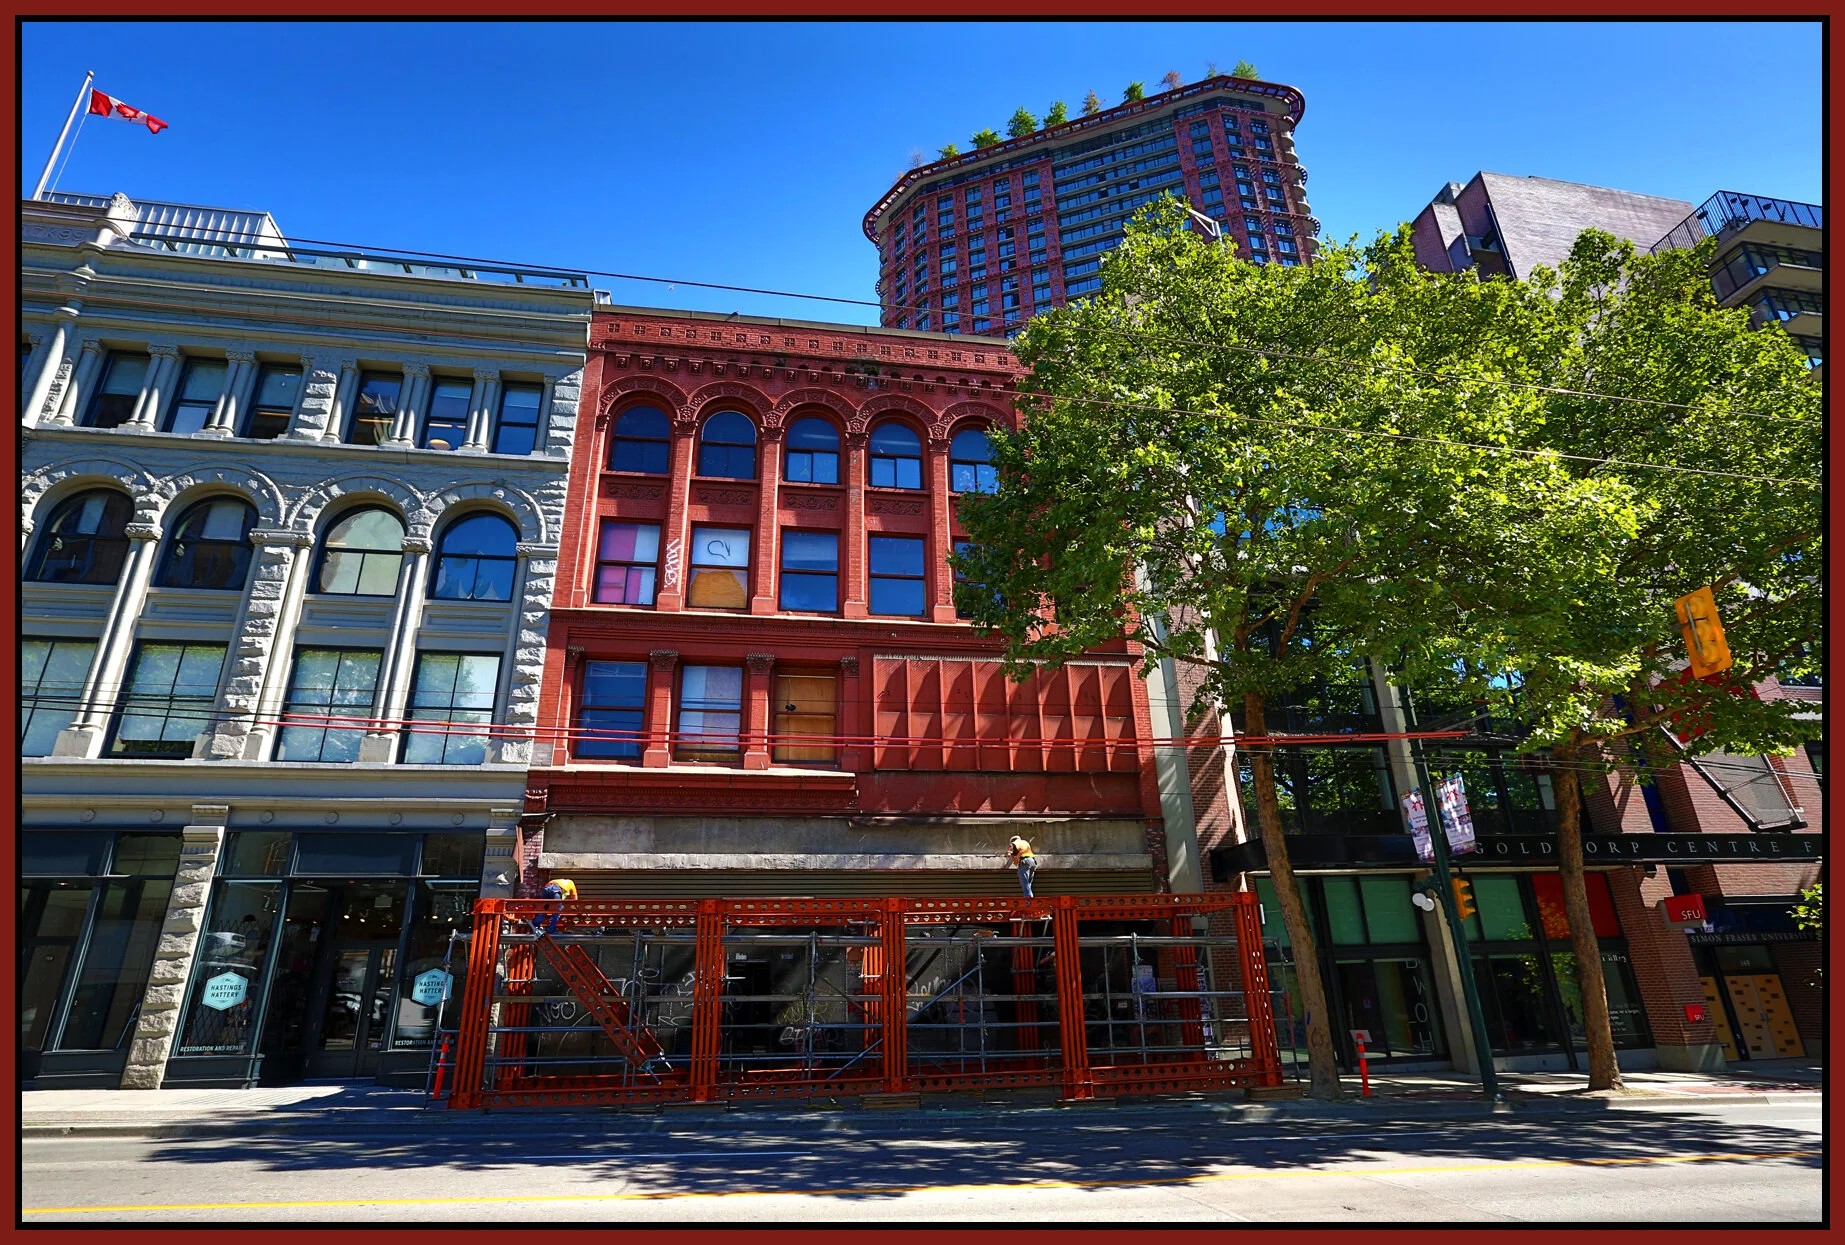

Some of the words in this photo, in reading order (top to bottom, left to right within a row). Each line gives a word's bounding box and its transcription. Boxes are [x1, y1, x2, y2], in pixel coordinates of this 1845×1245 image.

[1475, 842, 1639, 854] GOLDORP
[1667, 841, 1781, 853] CENTRE
[1804, 841, 1813, 853] F
[1681, 909, 1701, 920] SFU
[1690, 933, 1722, 943] SIMON
[1724, 932, 1758, 942] FRASER
[1761, 931, 1813, 941] UNIVERSITY
